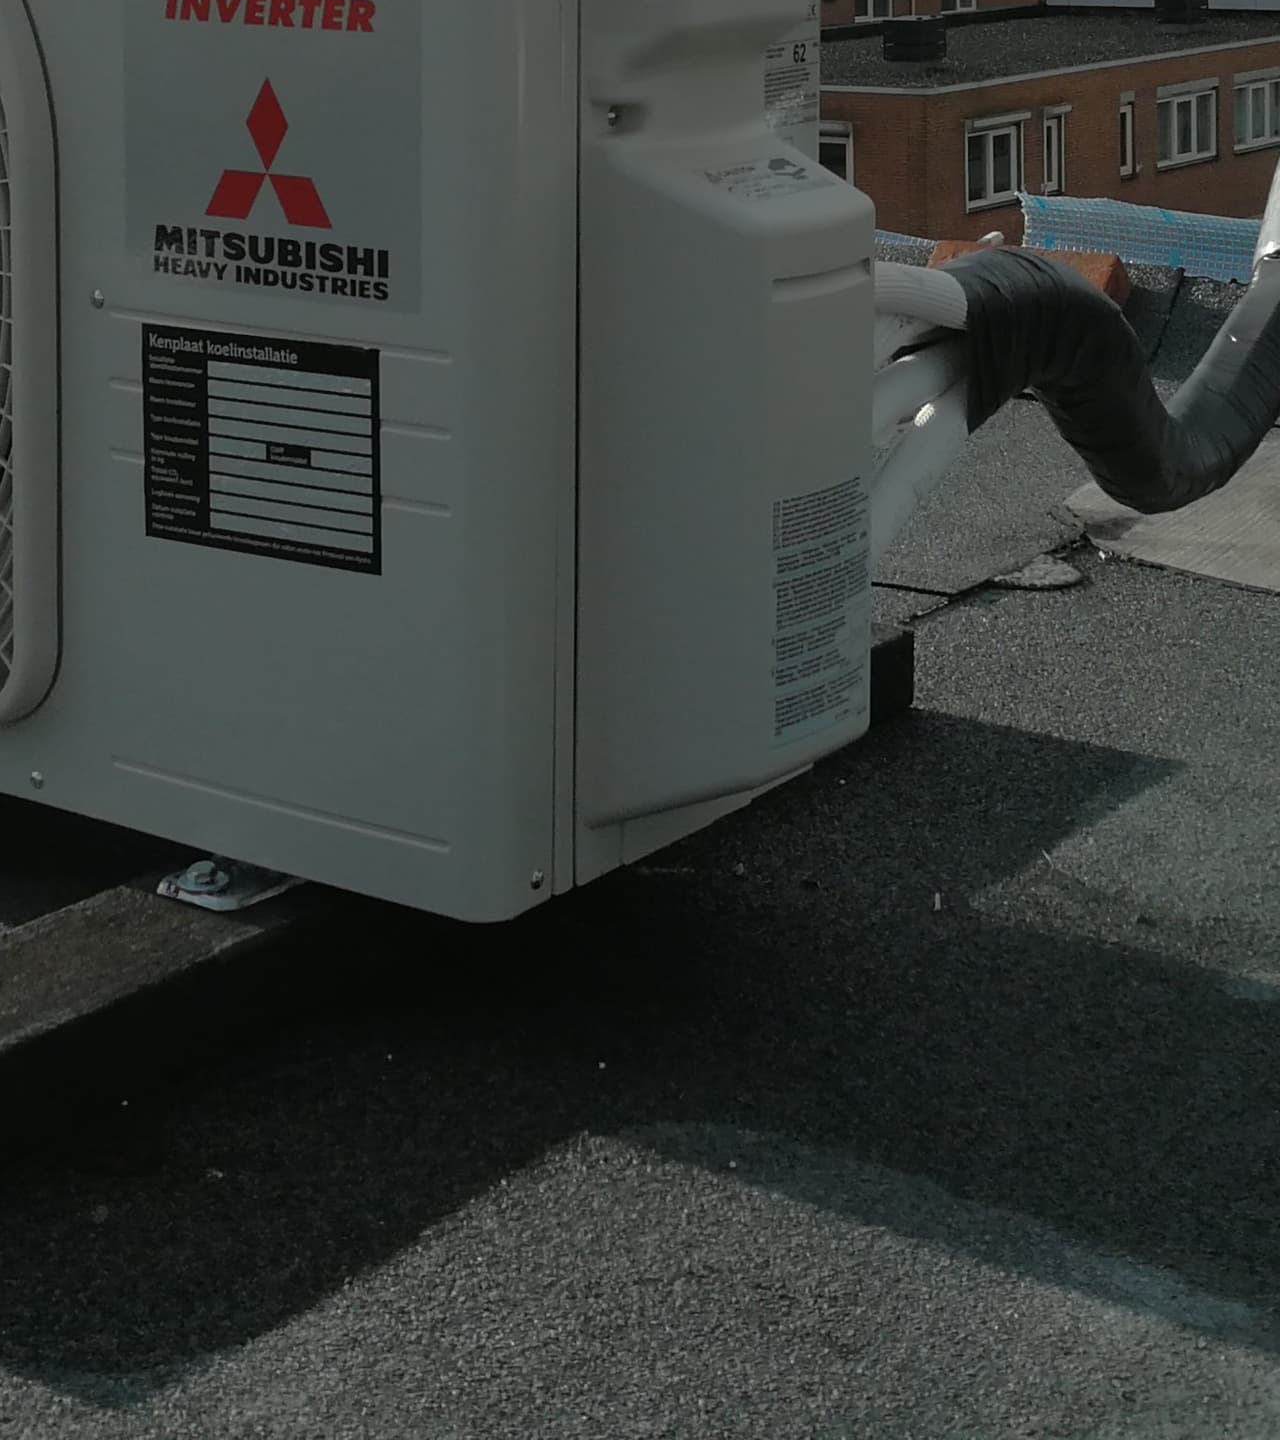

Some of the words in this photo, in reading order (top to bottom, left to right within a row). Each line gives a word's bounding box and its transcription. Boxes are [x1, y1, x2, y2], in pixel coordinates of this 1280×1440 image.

[793, 43, 806, 63] 62
[154, 224, 390, 279] MITSUBISHI
[154, 255, 228, 281] HEAVY
[235, 265, 389, 301] INDUSTRIES
[148, 332, 205, 354] Kenplaat
[206, 340, 298, 365] koelinstallatie
